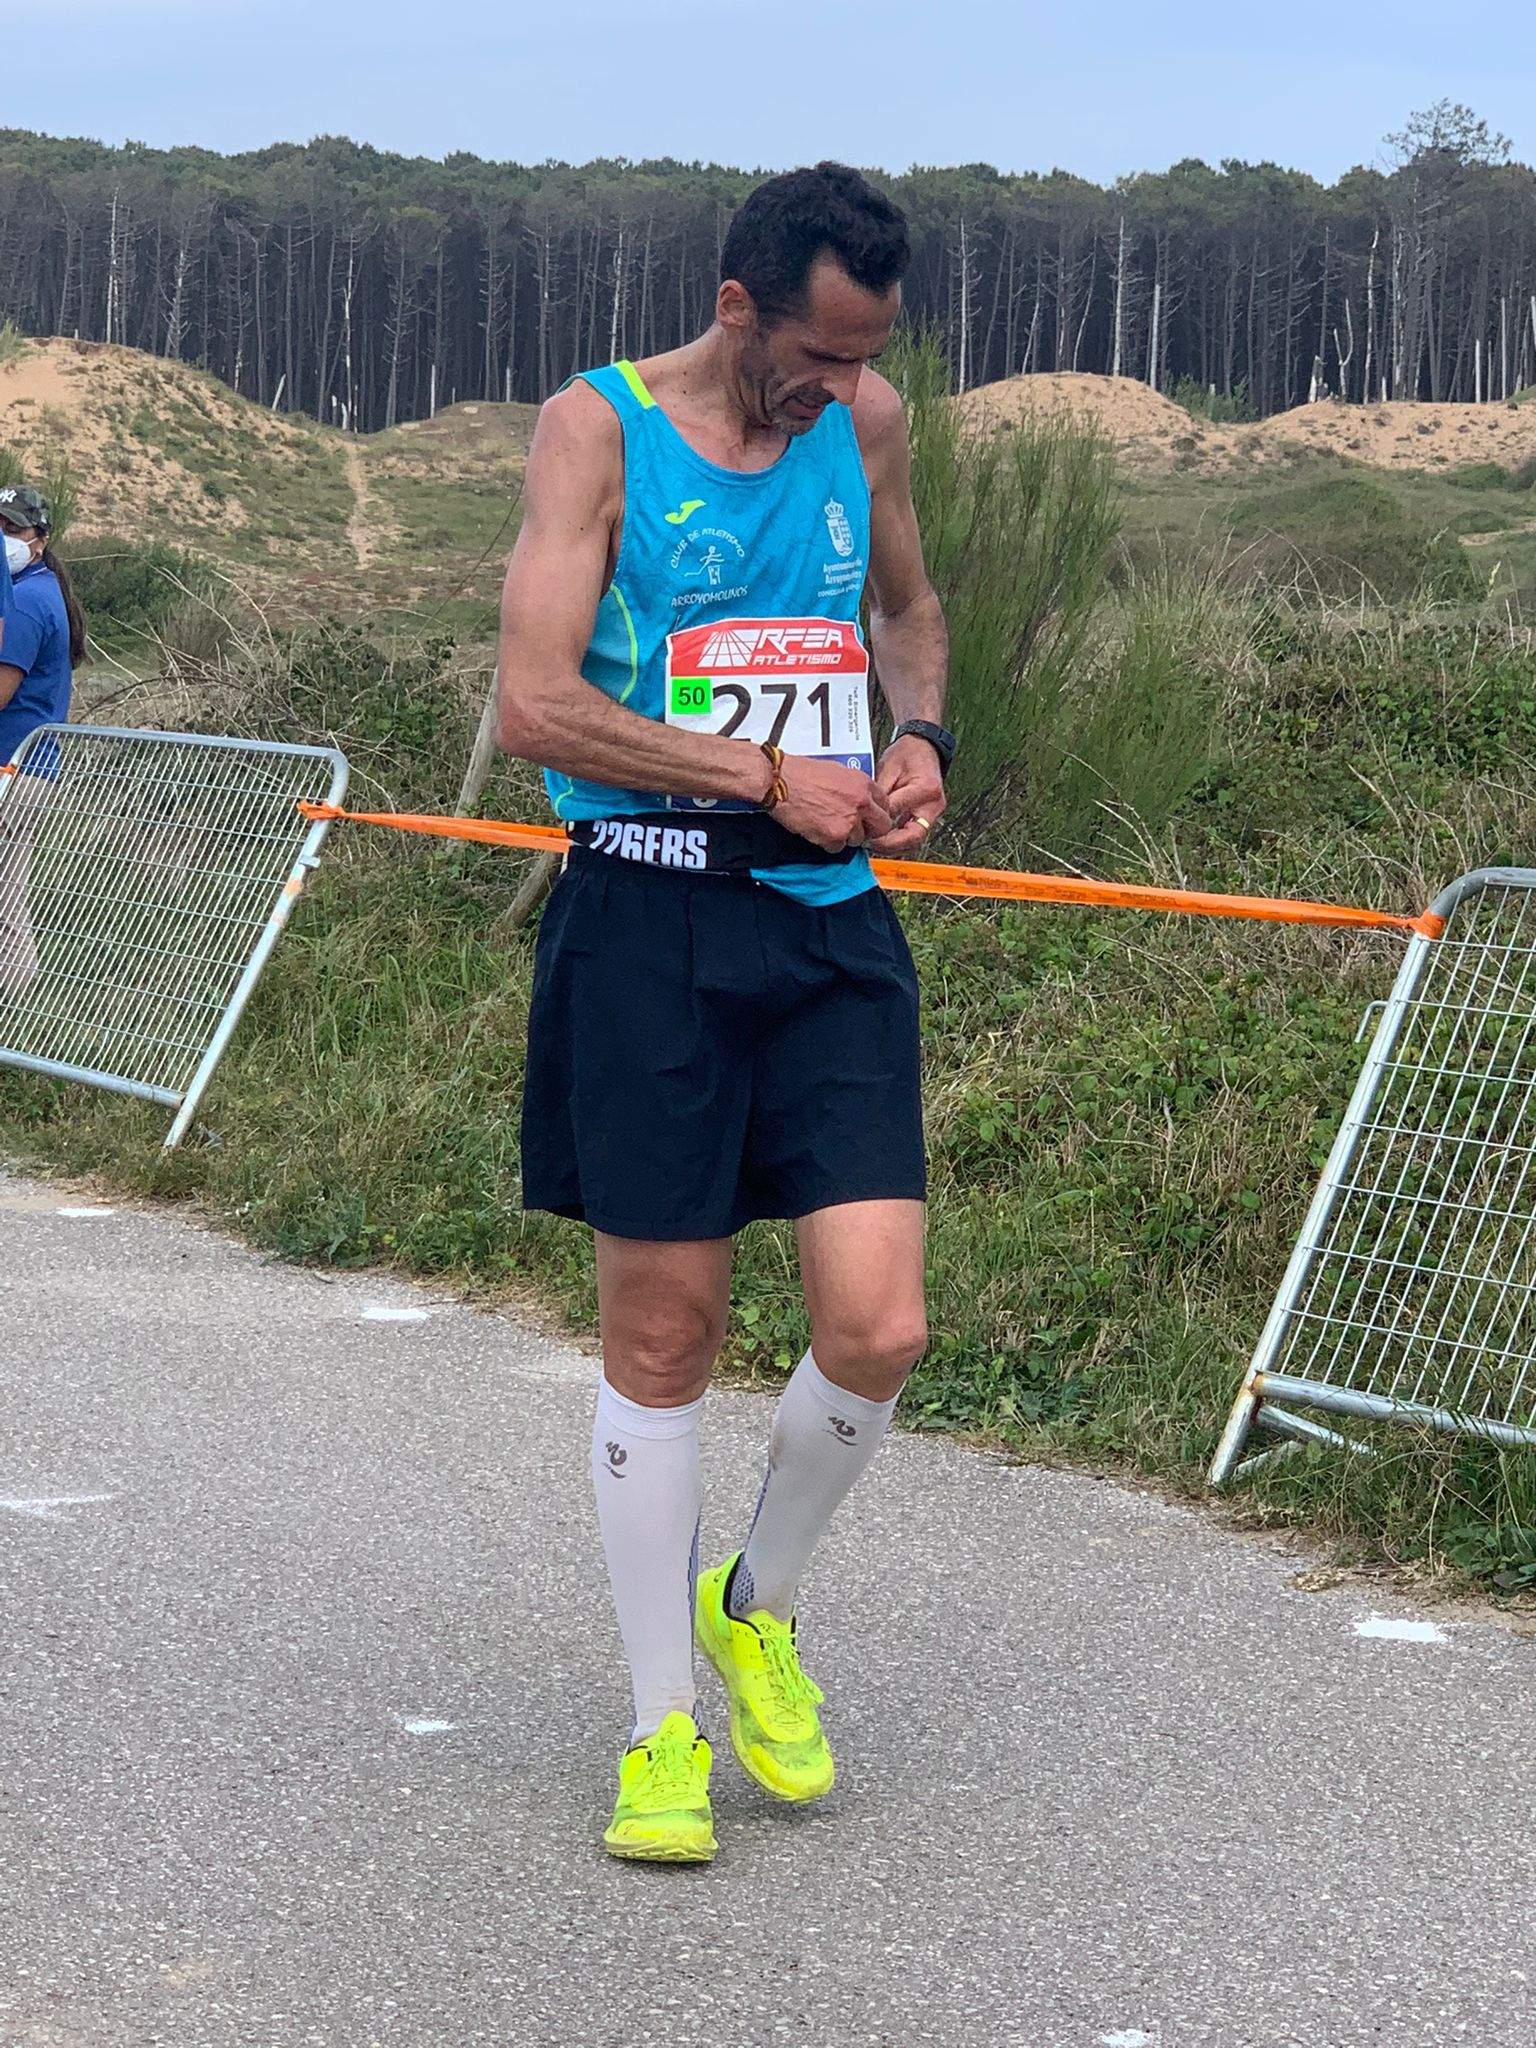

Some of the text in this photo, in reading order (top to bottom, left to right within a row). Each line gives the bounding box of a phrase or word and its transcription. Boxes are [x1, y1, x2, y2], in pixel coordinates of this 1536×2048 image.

[670, 527, 746, 570] CLUB DE ATLETISMO
[757, 627, 844, 655] RFEA
[751, 653, 842, 667] ATLETISMO
[677, 686, 706, 706] 50
[712, 682, 831, 748] 271
